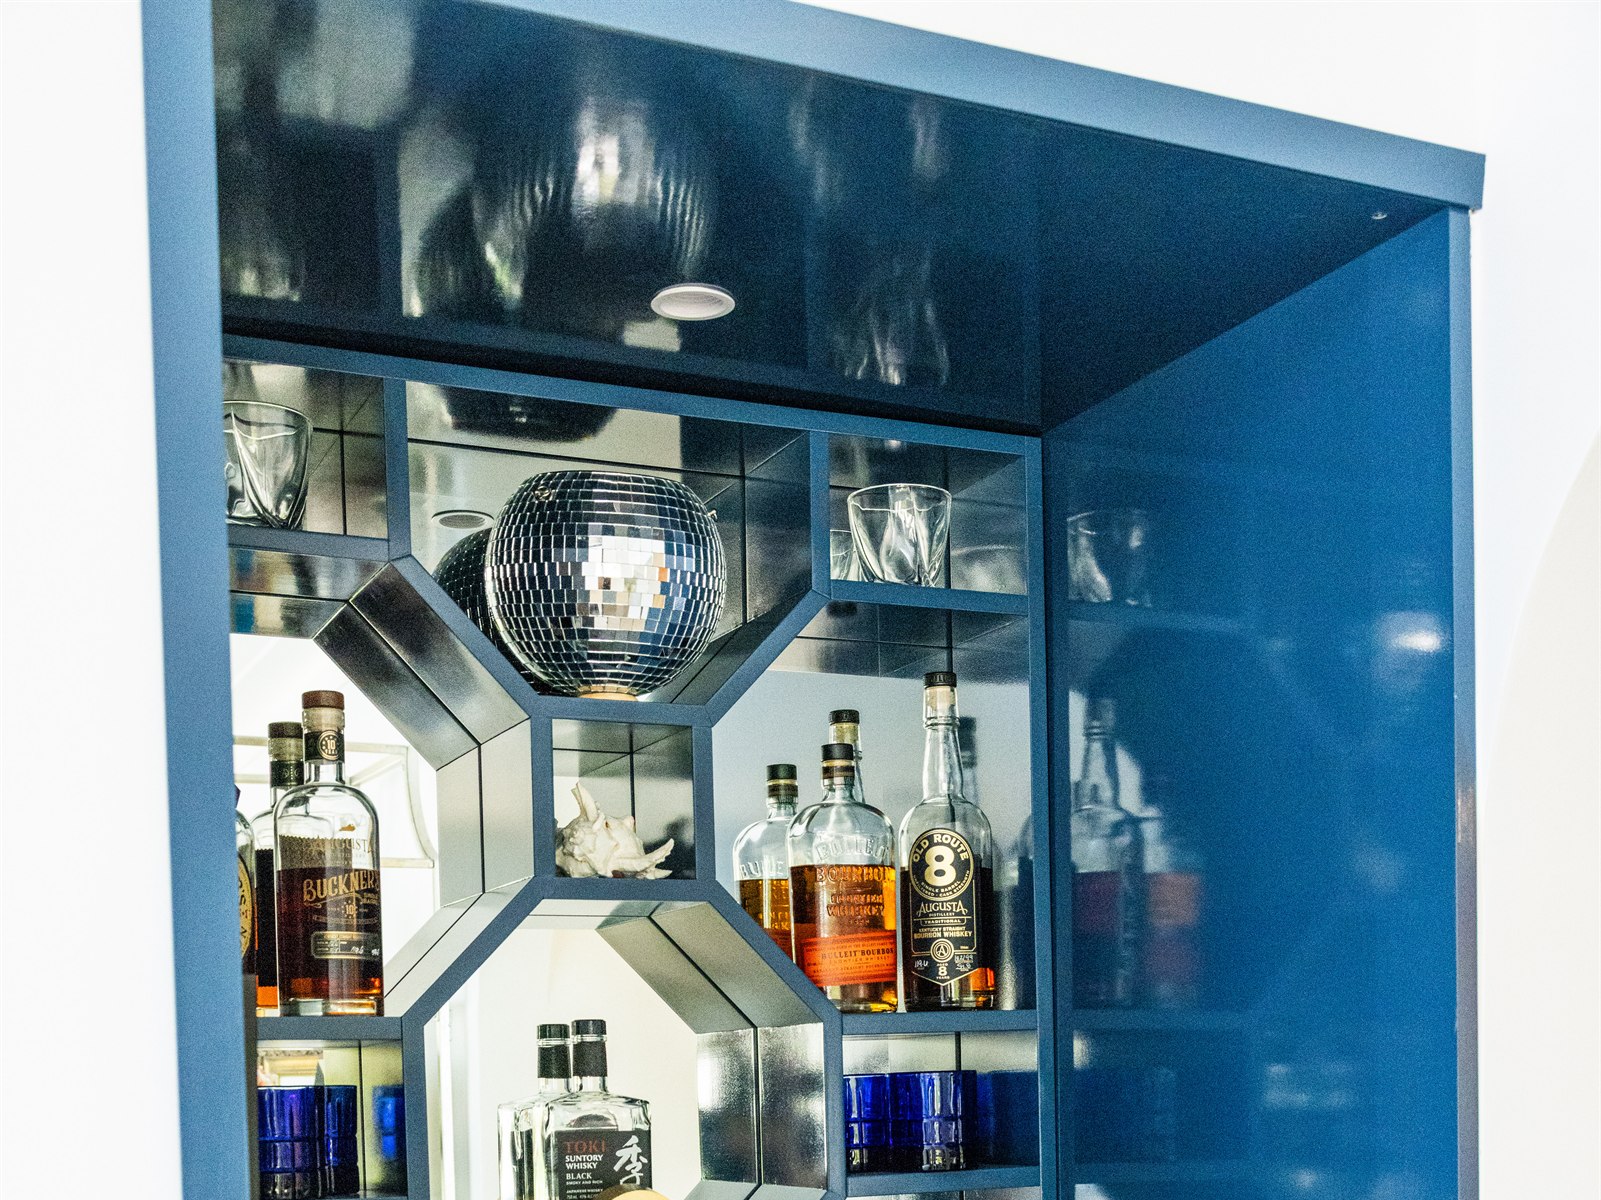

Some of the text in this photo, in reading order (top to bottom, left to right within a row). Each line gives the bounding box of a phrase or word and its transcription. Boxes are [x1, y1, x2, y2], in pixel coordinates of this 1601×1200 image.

[327, 740, 336, 750] 10
[913, 834, 969, 862] OLD ROUTE
[924, 845, 957, 887] 8
[921, 880, 961, 893] SINGLE BARREL
[915, 900, 969, 917] AUGUSTA
[913, 930, 972, 939] BOURBON WHISKEY
[821, 950, 858, 960] BULLEIT
[860, 947, 896, 957] BOURBON
[938, 966, 948, 976] 8
[564, 1137, 607, 1154] TOKI
[565, 1154, 604, 1163] SUNTORY
[613, 1135, 649, 1185] 季
[565, 1162, 598, 1171] WHISKY
[565, 1172, 592, 1180] BLACK
